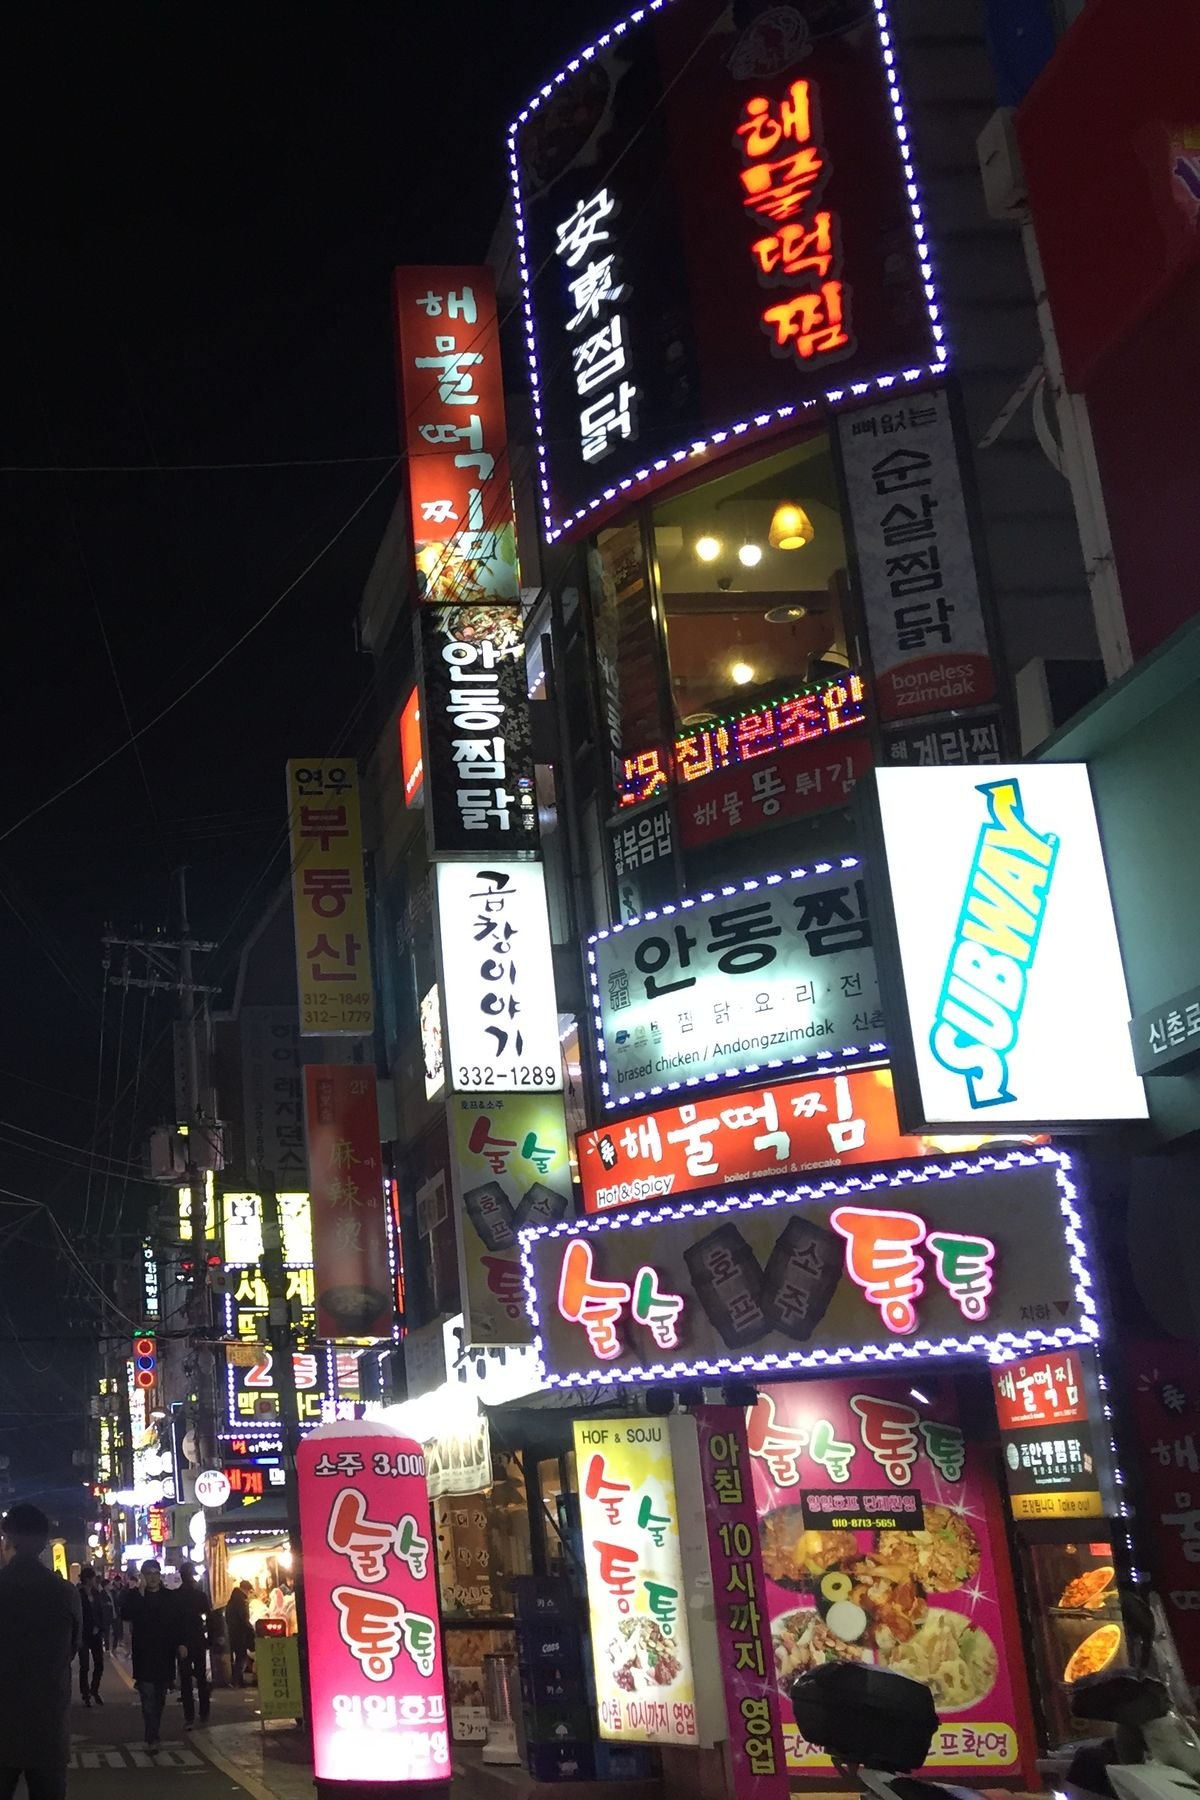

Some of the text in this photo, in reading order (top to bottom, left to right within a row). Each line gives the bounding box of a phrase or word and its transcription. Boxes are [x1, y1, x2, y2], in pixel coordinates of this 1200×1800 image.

[737, 79, 848, 358] 해물떡찜
[415, 286, 497, 561] 해물떡찜
[871, 448, 954, 650] 순살찜닭
[891, 662, 975, 690] boneless
[895, 680, 975, 706] zzimdak
[441, 639, 515, 831] 안동찜닭
[295, 768, 352, 796] 연우
[624, 811, 672, 871] 볶음밥
[299, 805, 362, 981] 부동산
[634, 880, 873, 1000] 안동찜
[929, 778, 1060, 1109] SUBWAY
[458, 1066, 556, 1086] 332-1289
[617, 1059, 652, 1084] brased
[655, 1048, 701, 1072] chicken
[714, 1018, 834, 1059] Andongzzimdak
[620, 1076, 867, 1177] 해물떡찜
[596, 1188, 620, 1208] Hot
[634, 1174, 676, 1200] Spicy
[724, 1171, 751, 1184] boiled
[752, 1166, 788, 1180] seafood
[800, 1157, 842, 1172] ricecake
[997, 1357, 1079, 1412] 해물떡찜
[582, 1429, 609, 1445] HOF
[626, 1428, 662, 1443] SOJU
[315, 1453, 425, 1478] 소주 3,000
[806, 1495, 860, 1512] 일일호프
[832, 1518, 896, 1528] 010-8713-5651
[709, 1432, 776, 1776] 아침 10시까지 영업
[601, 1698, 696, 1736] 아침 10시까지 영업
